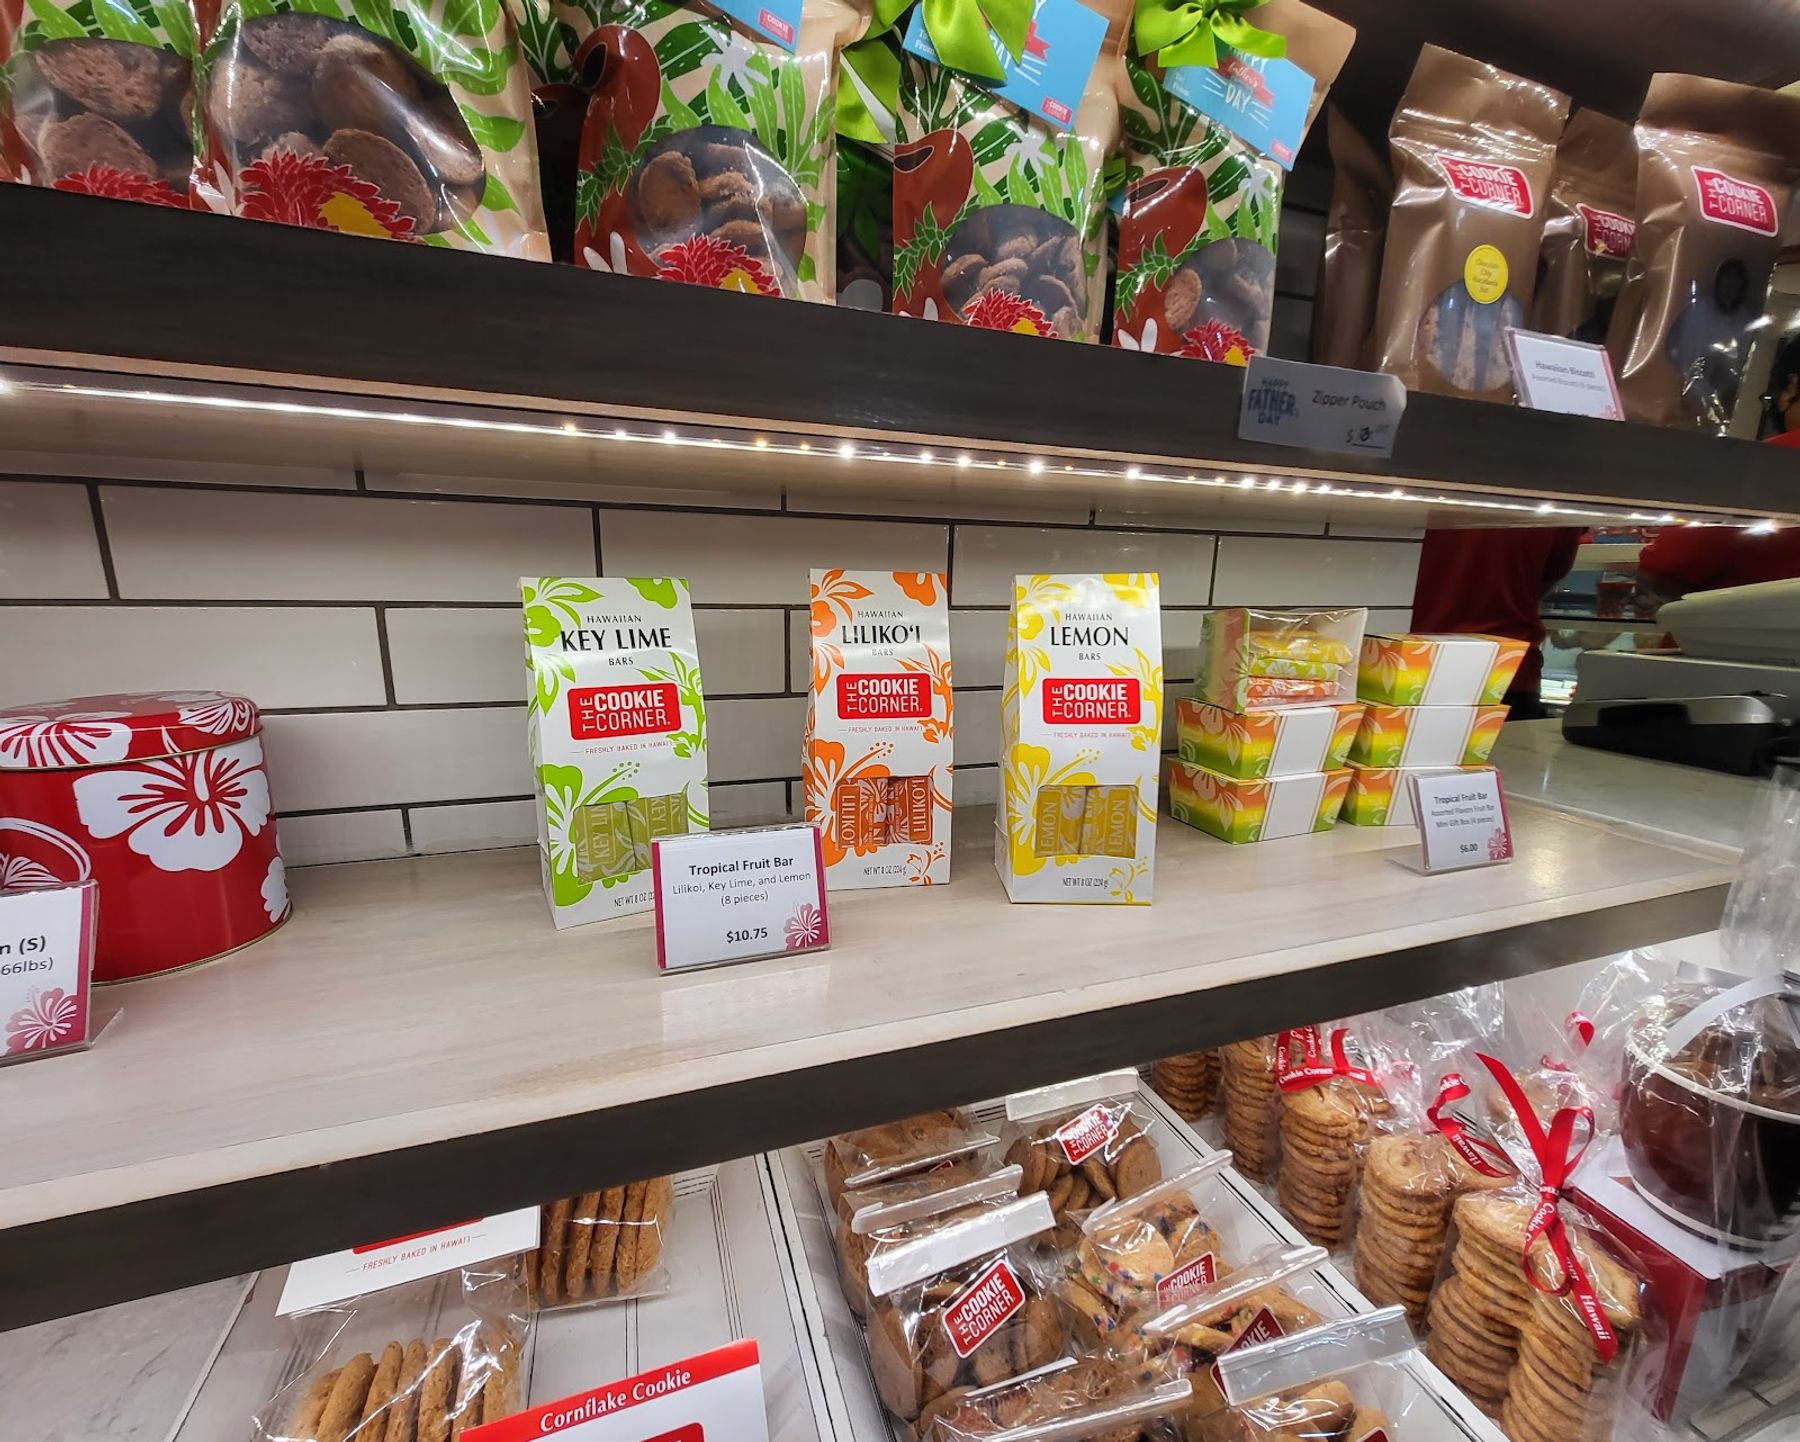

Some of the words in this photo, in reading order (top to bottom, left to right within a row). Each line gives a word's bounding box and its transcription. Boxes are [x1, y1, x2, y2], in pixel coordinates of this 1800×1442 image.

[1225, 82, 1251, 113] DAY
[1459, 164, 1518, 187] COOKIE
[1710, 178, 1765, 205] COOKIE
[1718, 195, 1769, 224] CORNER
[1311, 390, 1350, 408] Zipper
[1351, 394, 1387, 412] Pouch
[1258, 411, 1281, 426] DAY
[586, 614, 642, 624] HAWAIIAN
[857, 610, 904, 618] HAWAIIAN
[1065, 613, 1113, 621] HAWAIIAN
[560, 629, 606, 652] KEY
[615, 627, 672, 650] LIME
[1050, 626, 1129, 646] LEMON
[608, 656, 634, 667] BARS
[871, 648, 894, 657] BARS
[1078, 652, 1101, 661] BARS
[845, 681, 858, 713] THE
[857, 678, 920, 696] COOKIE
[1063, 683, 1128, 701] COOKIE
[593, 689, 665, 712] COOKIE
[1052, 686, 1063, 717] THE
[579, 696, 596, 732] THE
[1433, 793, 1460, 804] Tropical
[1461, 792, 1476, 802] Fruit
[1477, 791, 1488, 800] Bar
[1108, 799, 1126, 854] LEMON
[592, 832, 610, 859] KEY
[1460, 844, 1478, 853] $6.00
[688, 860, 740, 877] Tropical
[742, 857, 771, 871] Fruit
[773, 856, 794, 868] Bar
[672, 883, 705, 895] Lilikoi,
[708, 880, 727, 892] Key
[729, 877, 756, 889] Lime,
[758, 874, 777, 885] and
[779, 872, 812, 883] Lemon
[614, 896, 625, 908] NET
[721, 894, 732, 907] (8
[734, 891, 769, 906] pieces)
[19, 935, 46, 955] (S)
[726, 926, 768, 944] $10.75
[1280, 1069, 1304, 1084] Cookie
[1304, 1067, 1334, 1076] Corner
[1451, 1133, 1481, 1166] Hawaii
[1528, 1201, 1555, 1232] Cookie
[362, 1255, 398, 1271] FRESHLY
[400, 1248, 427, 1262] BAKED
[429, 1244, 438, 1253] IN
[1169, 1260, 1207, 1291] COOKIE
[960, 1272, 1006, 1322] COOKIE
[1580, 1293, 1612, 1341] Hawaii
[953, 1312, 973, 1346] THE
[540, 1391, 627, 1432] Cornflake
[632, 1369, 691, 1401] Cookie
